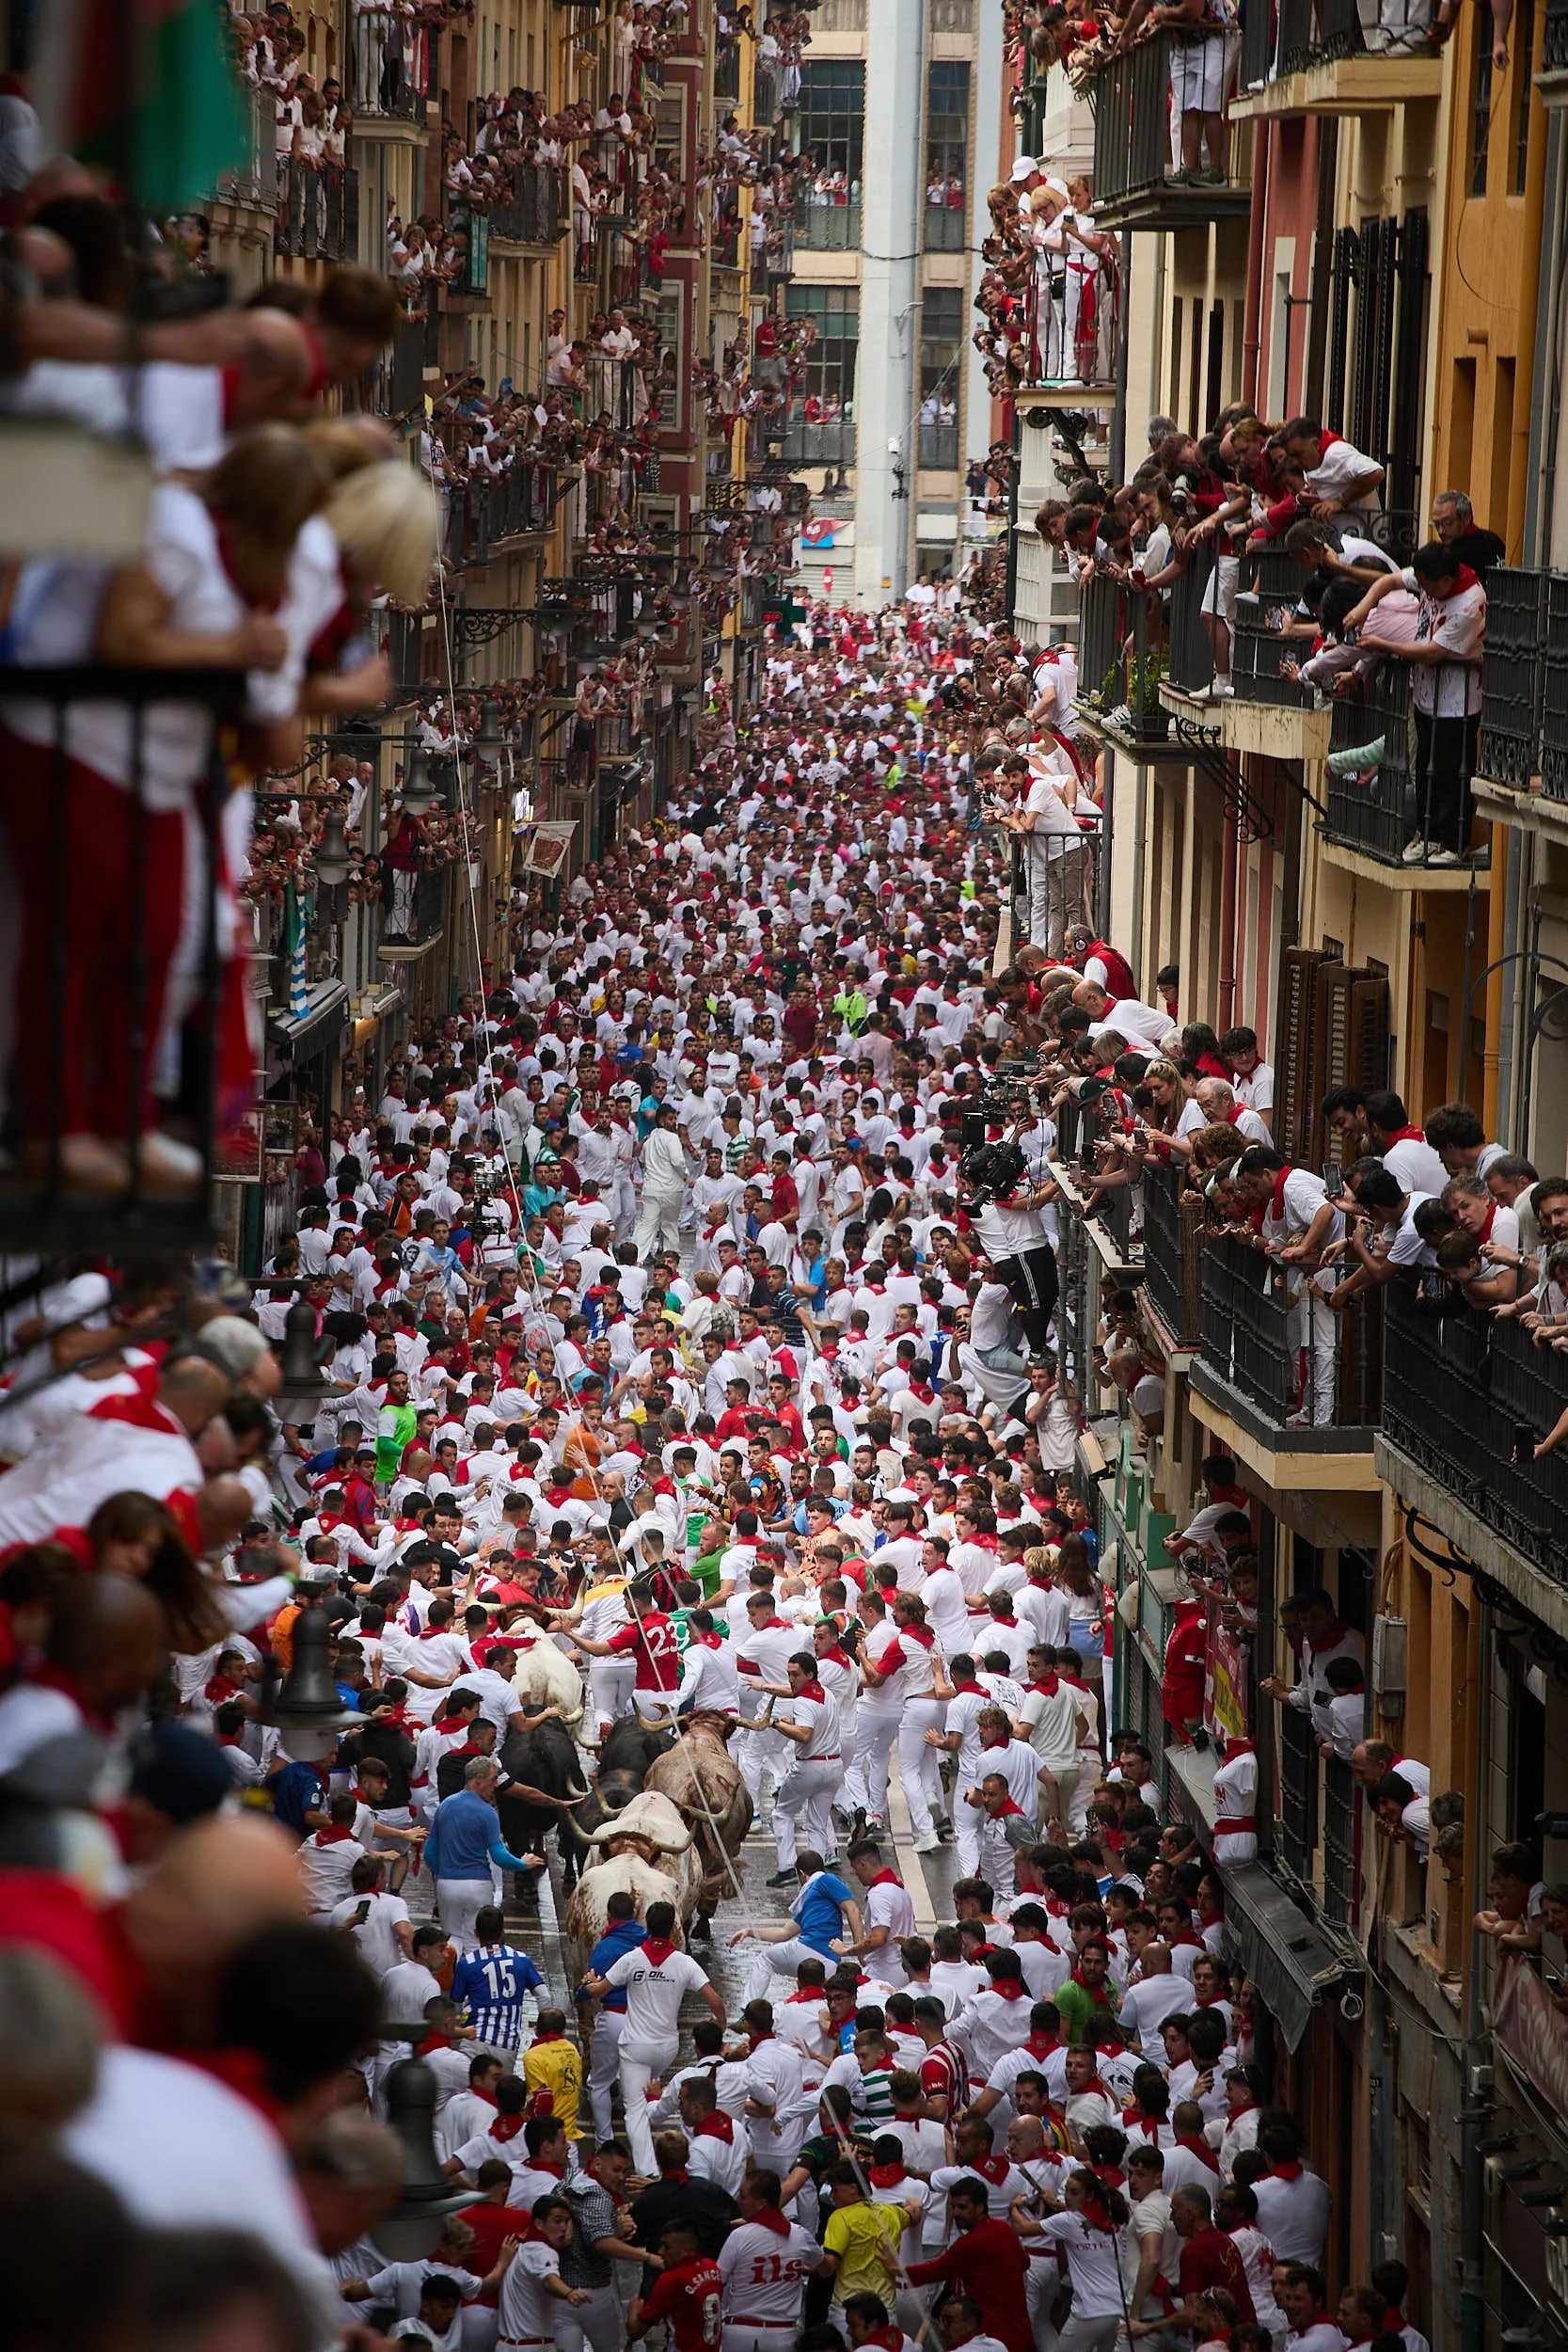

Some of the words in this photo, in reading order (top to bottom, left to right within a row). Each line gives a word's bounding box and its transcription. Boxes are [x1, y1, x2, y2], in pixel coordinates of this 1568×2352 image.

[646, 1620, 677, 1658] 23
[482, 1959, 516, 2000] 15
[702, 2293, 721, 2345] 8
